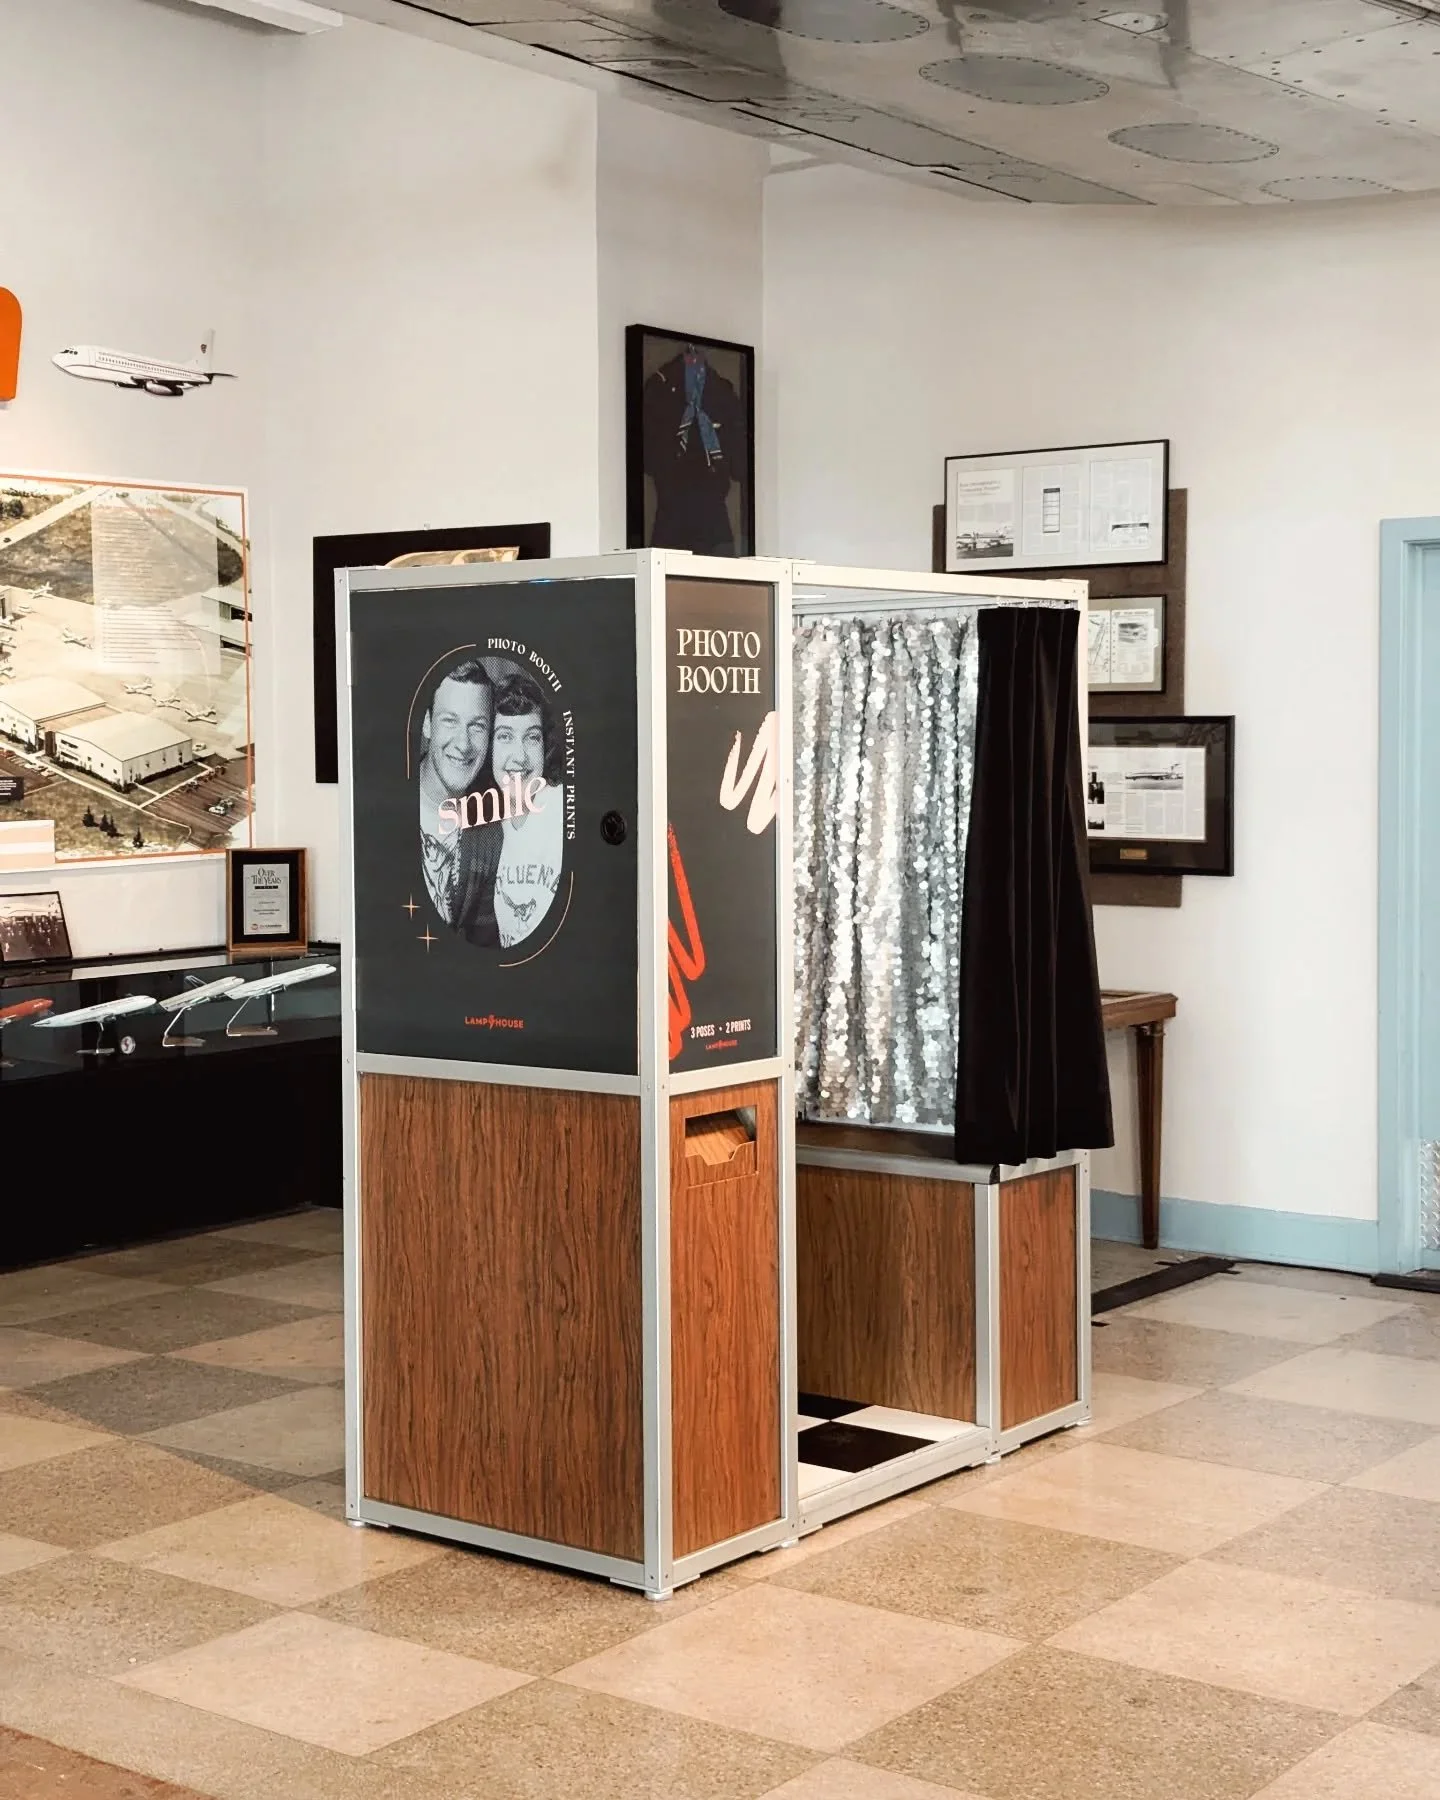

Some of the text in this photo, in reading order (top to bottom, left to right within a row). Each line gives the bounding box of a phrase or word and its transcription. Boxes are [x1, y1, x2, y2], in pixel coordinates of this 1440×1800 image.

[487, 637, 562, 693] PHOTO BOOTH
[676, 628, 761, 659] PHOTO
[676, 665, 761, 694] BOOTH
[562, 710, 577, 841] INSTANT PRINTS
[437, 771, 547, 835] smile
[690, 1018, 752, 1039] 3 POSES 2 PRINTS
